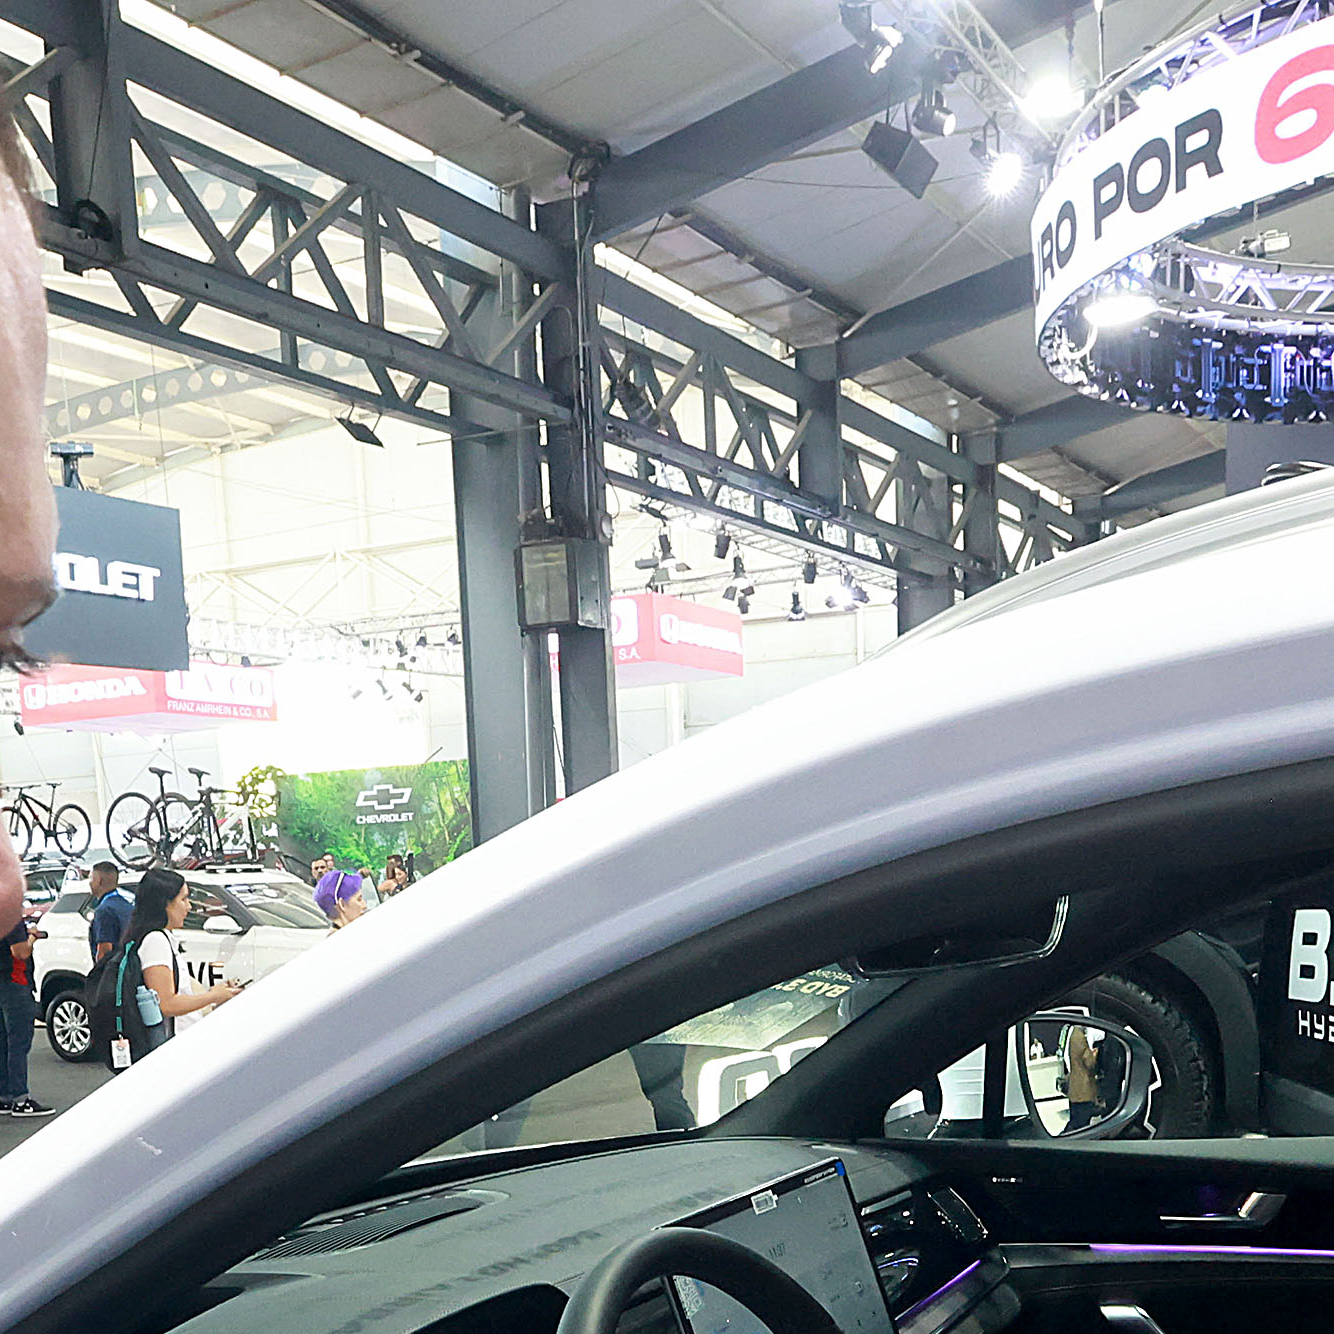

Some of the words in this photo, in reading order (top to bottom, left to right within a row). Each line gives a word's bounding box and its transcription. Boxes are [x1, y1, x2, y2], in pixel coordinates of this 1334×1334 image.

[1093, 108, 1224, 241] POR
[47, 676, 147, 705] HONDA
[168, 700, 196, 713] FRANZ
[196, 703, 231, 716] AMRHEIN
[356, 813, 414, 824] CHEVROLET
